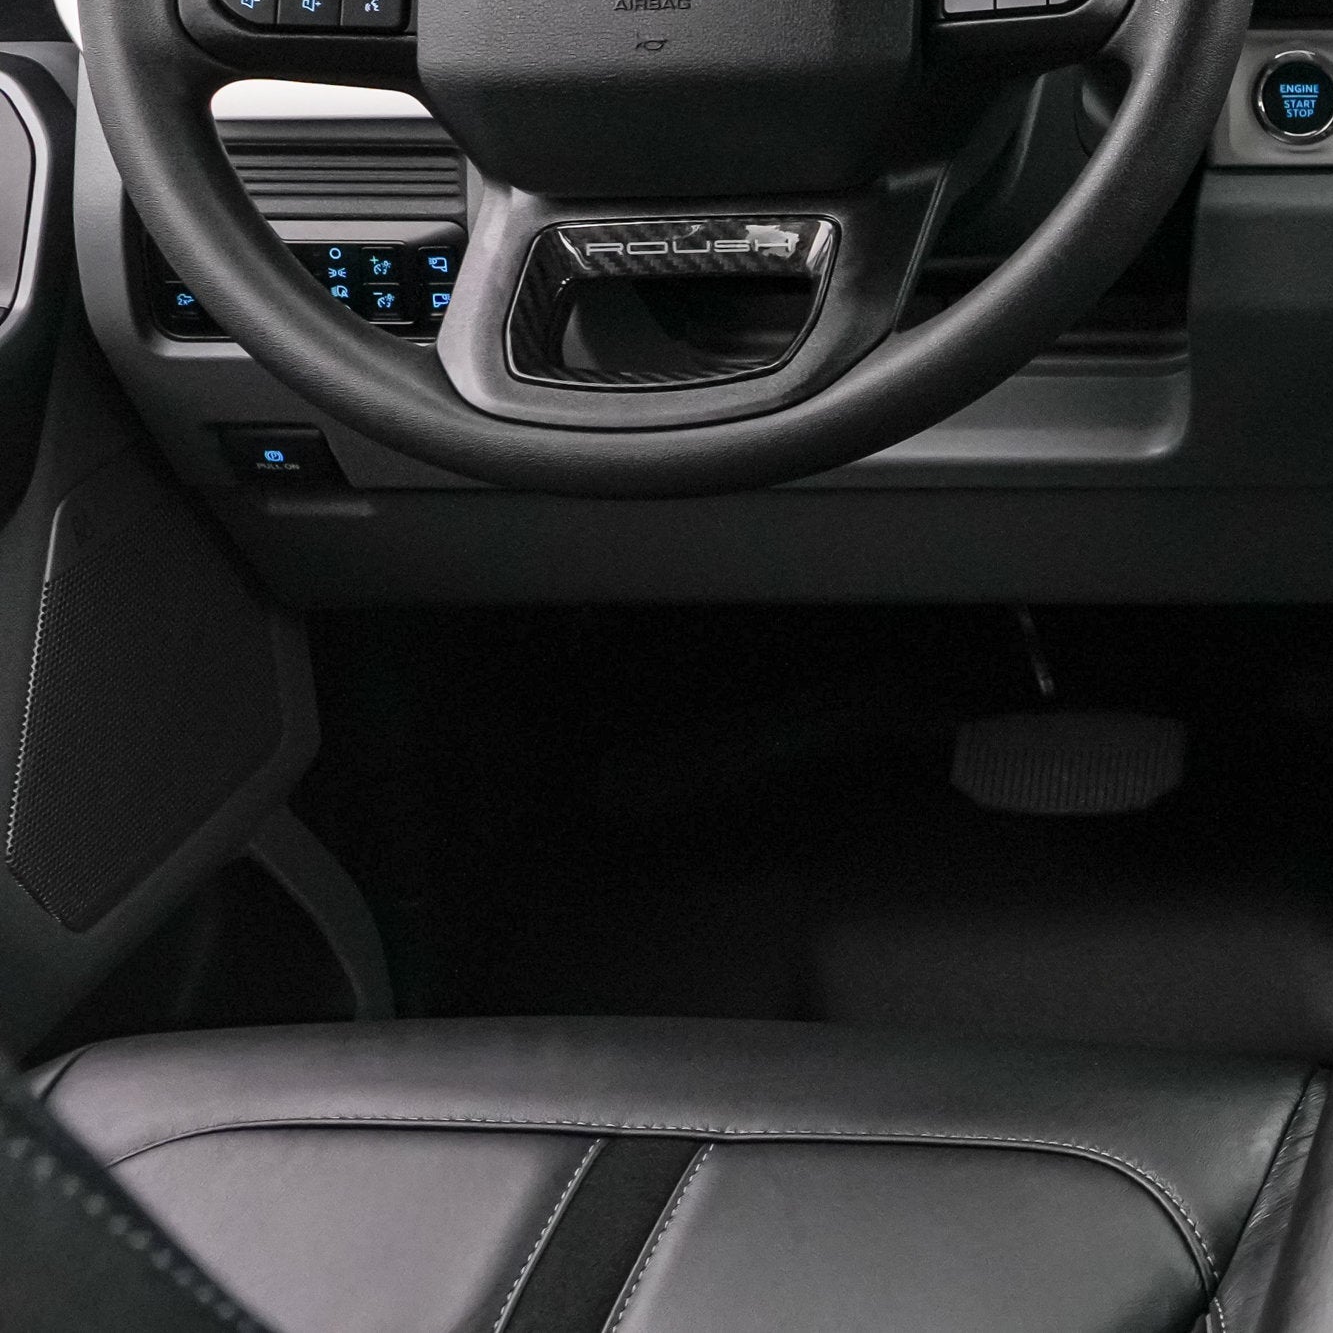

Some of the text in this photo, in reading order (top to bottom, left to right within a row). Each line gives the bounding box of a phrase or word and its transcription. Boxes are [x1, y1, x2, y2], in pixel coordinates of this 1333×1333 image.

[1279, 83, 1319, 94] ENGINE
[1283, 99, 1317, 109] START
[1286, 108, 1314, 118] STOP
[586, 240, 794, 256] ROUSH
